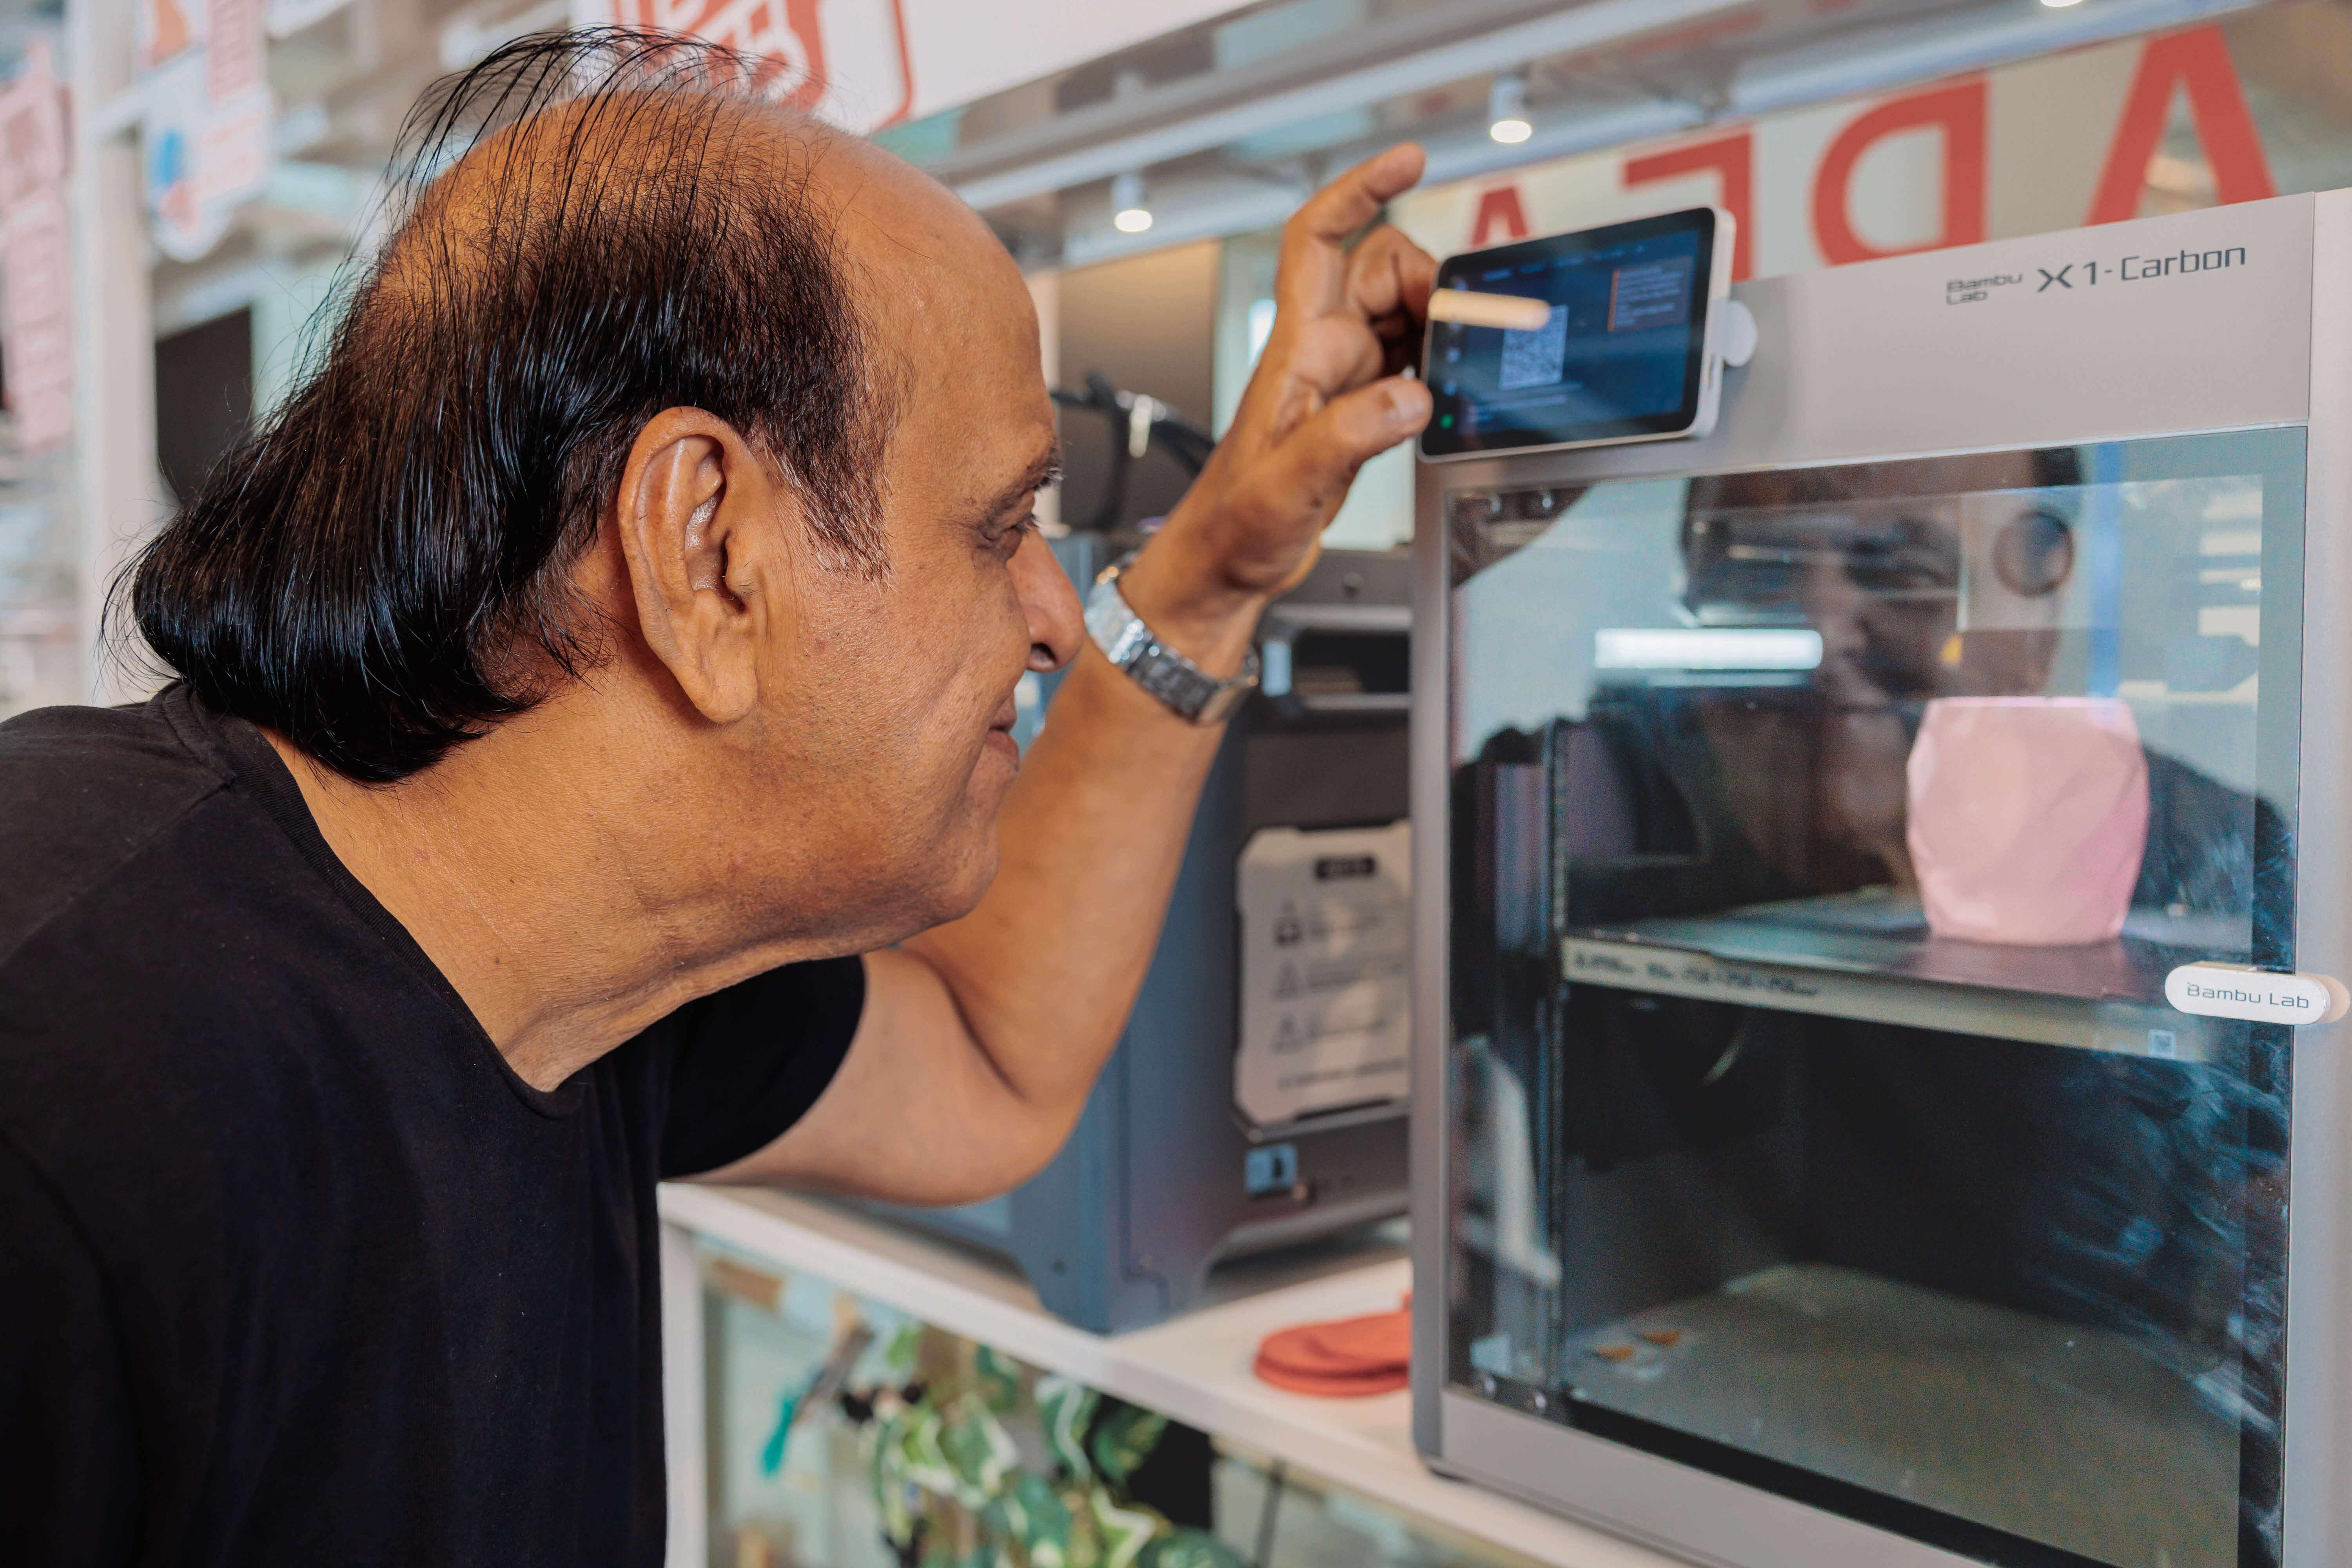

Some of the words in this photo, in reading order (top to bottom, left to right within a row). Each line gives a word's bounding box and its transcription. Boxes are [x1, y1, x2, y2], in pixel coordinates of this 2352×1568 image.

[1947, 273, 2023, 293] Bambu
[1946, 290, 1988, 305] Lab
[2187, 982, 2261, 1004] Bambu
[2269, 992, 2309, 1009] Lab
